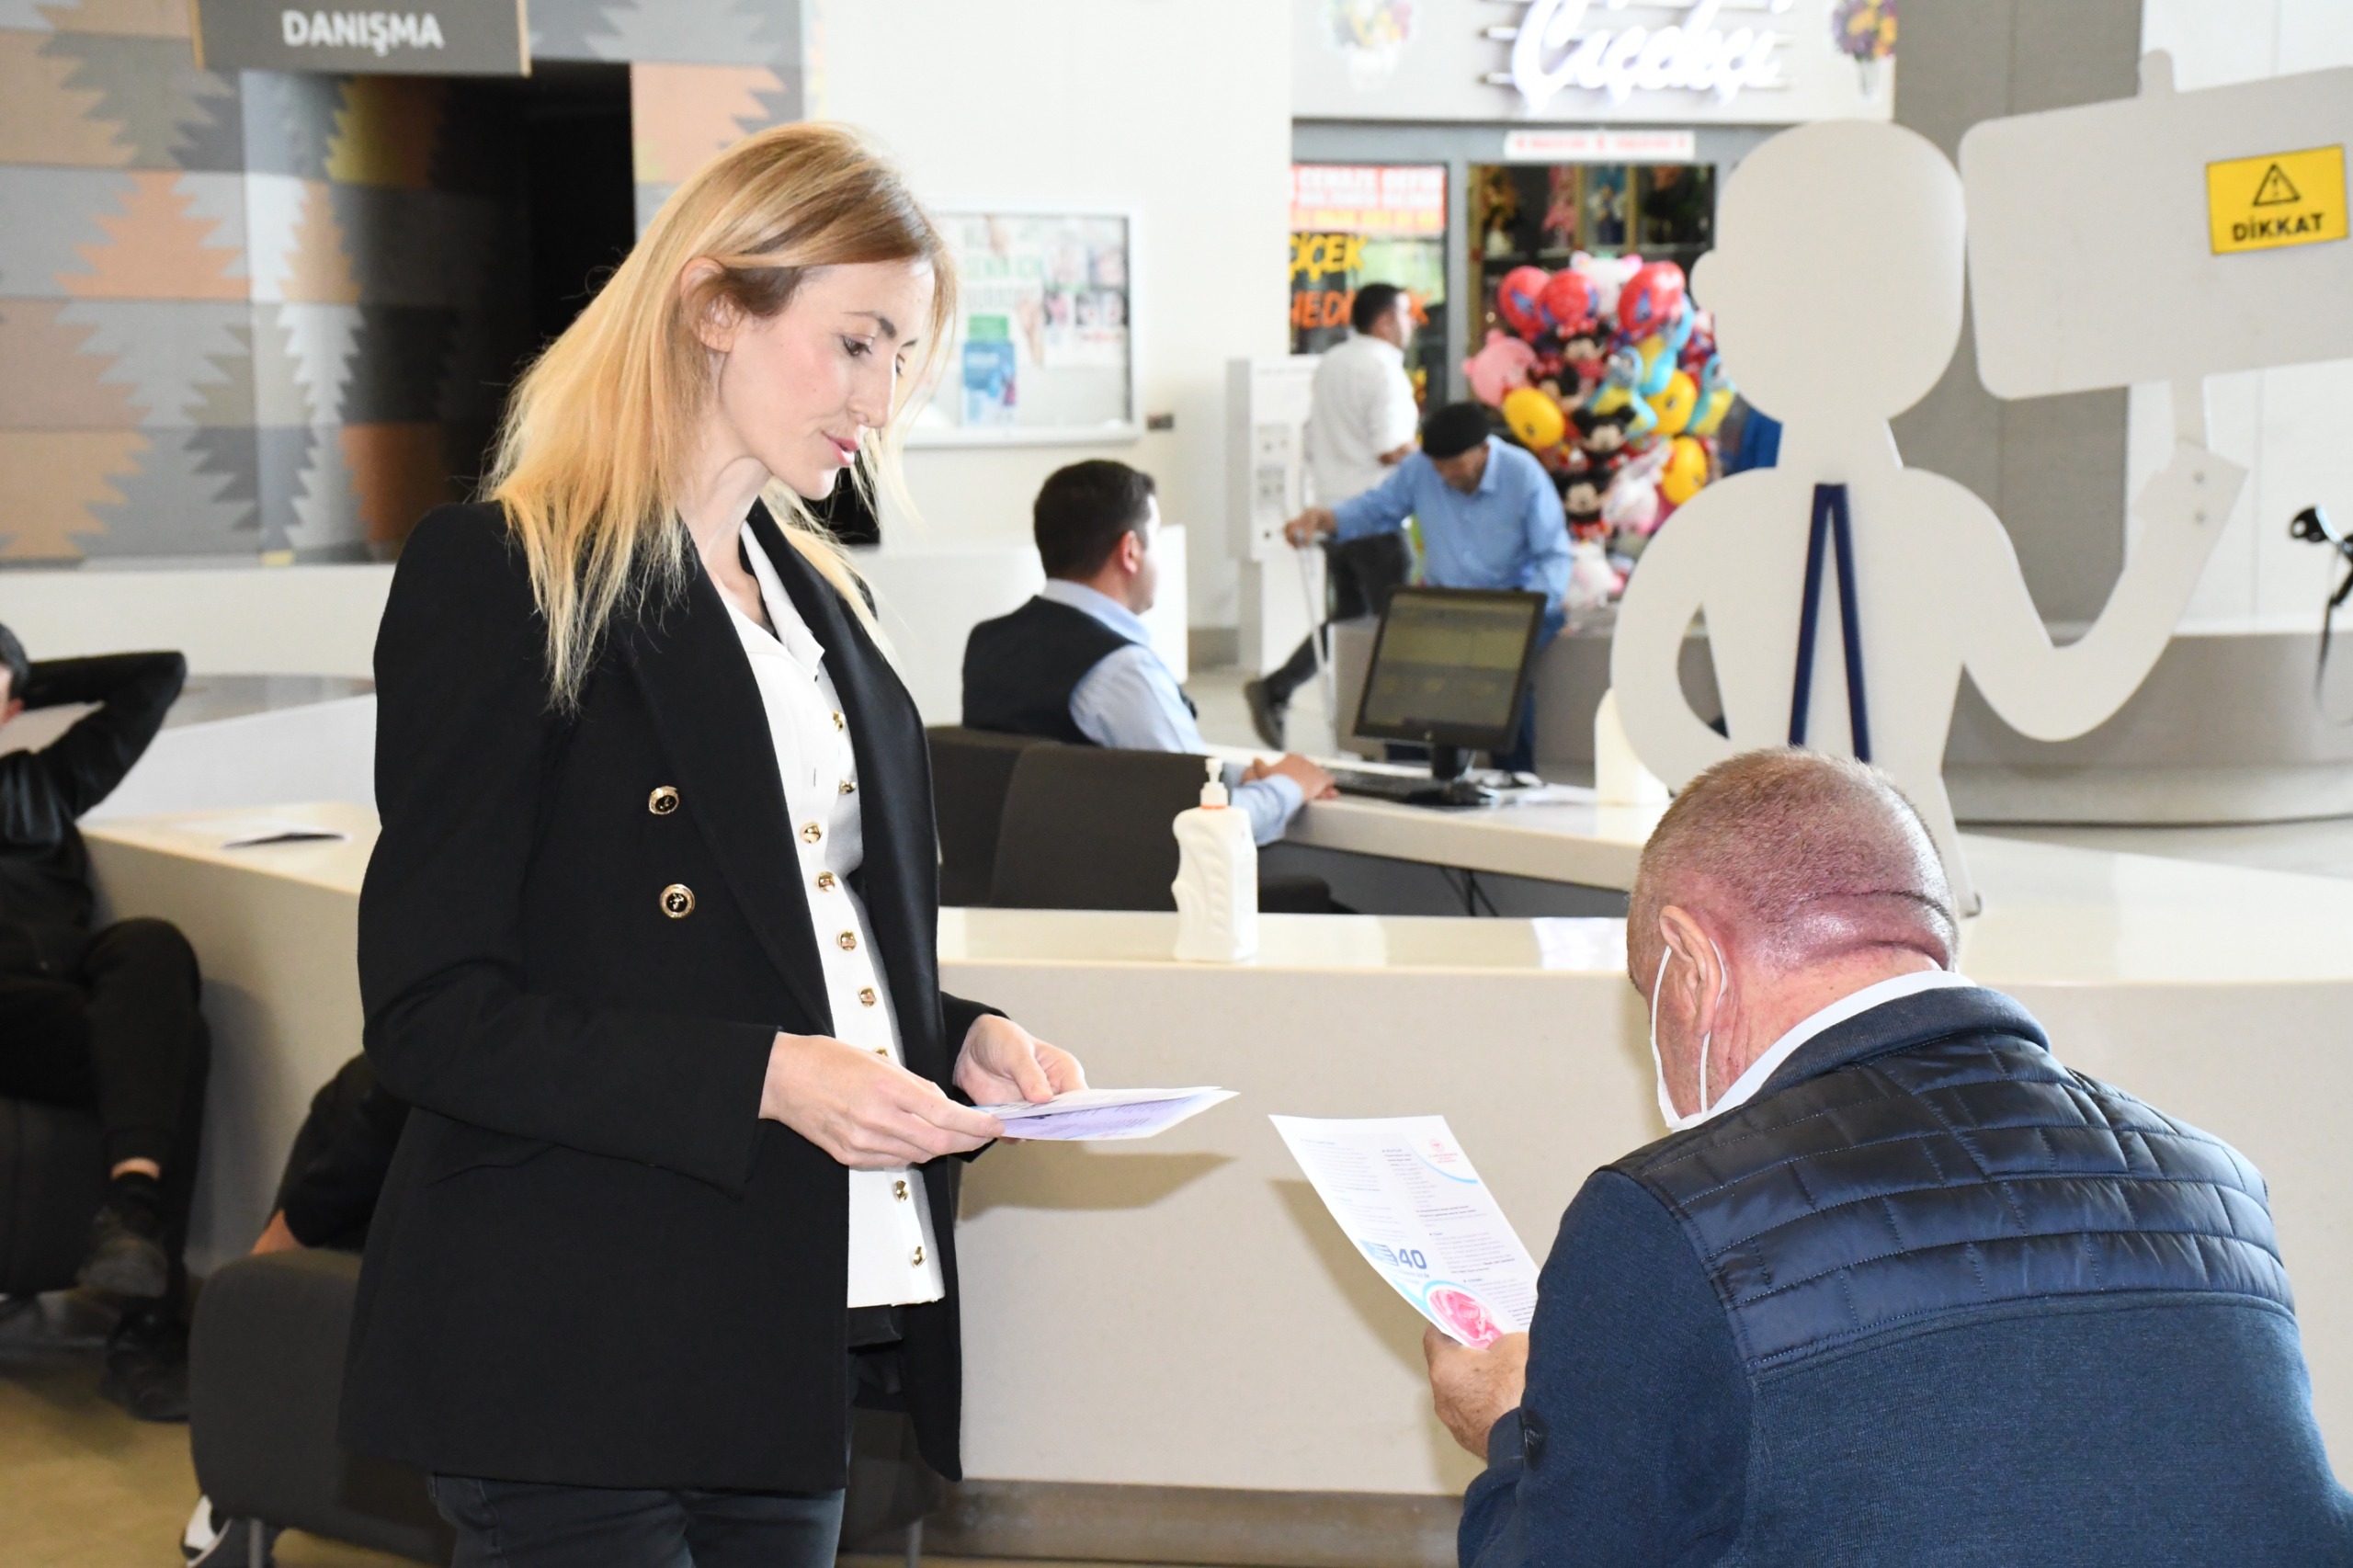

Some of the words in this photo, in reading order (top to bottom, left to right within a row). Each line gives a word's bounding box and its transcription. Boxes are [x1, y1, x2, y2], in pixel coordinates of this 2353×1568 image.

[281, 9, 445, 57] DANIŞMA
[2232, 211, 2323, 242] DİKKAT
[1399, 1248, 1427, 1269] 40
